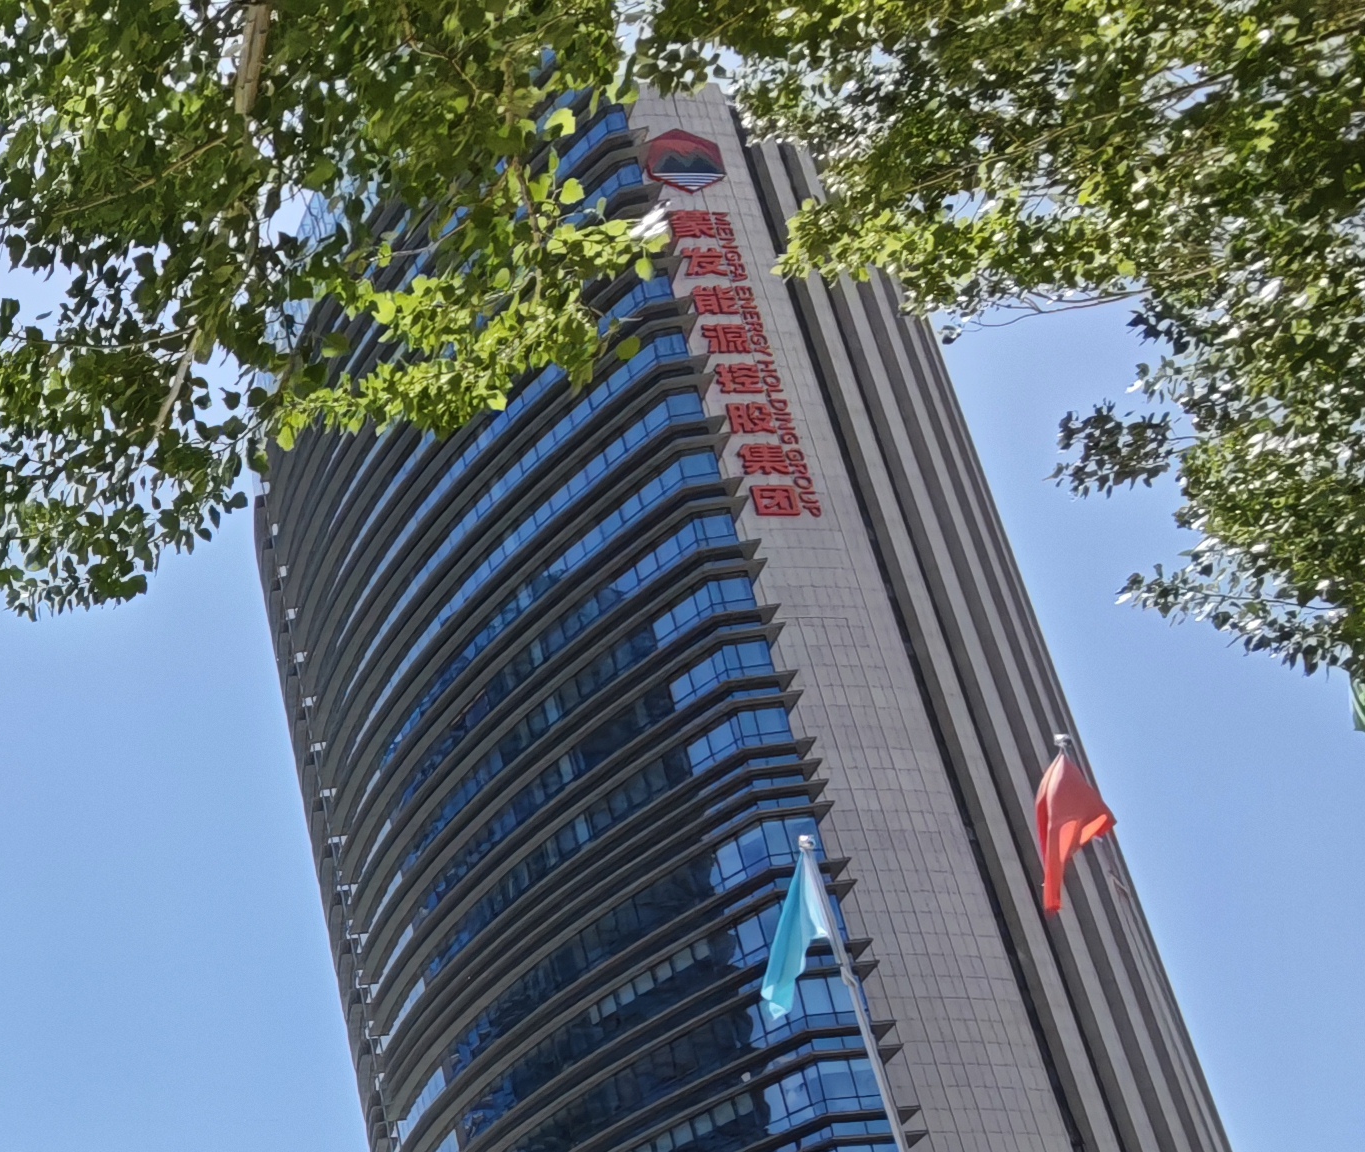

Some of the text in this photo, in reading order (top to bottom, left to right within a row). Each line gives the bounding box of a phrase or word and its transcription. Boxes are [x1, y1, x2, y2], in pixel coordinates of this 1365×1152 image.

[671, 209, 801, 517] 蒙发能源控股集团
[712, 211, 822, 518] MENGFA ENERGY HOLDING GROUP
